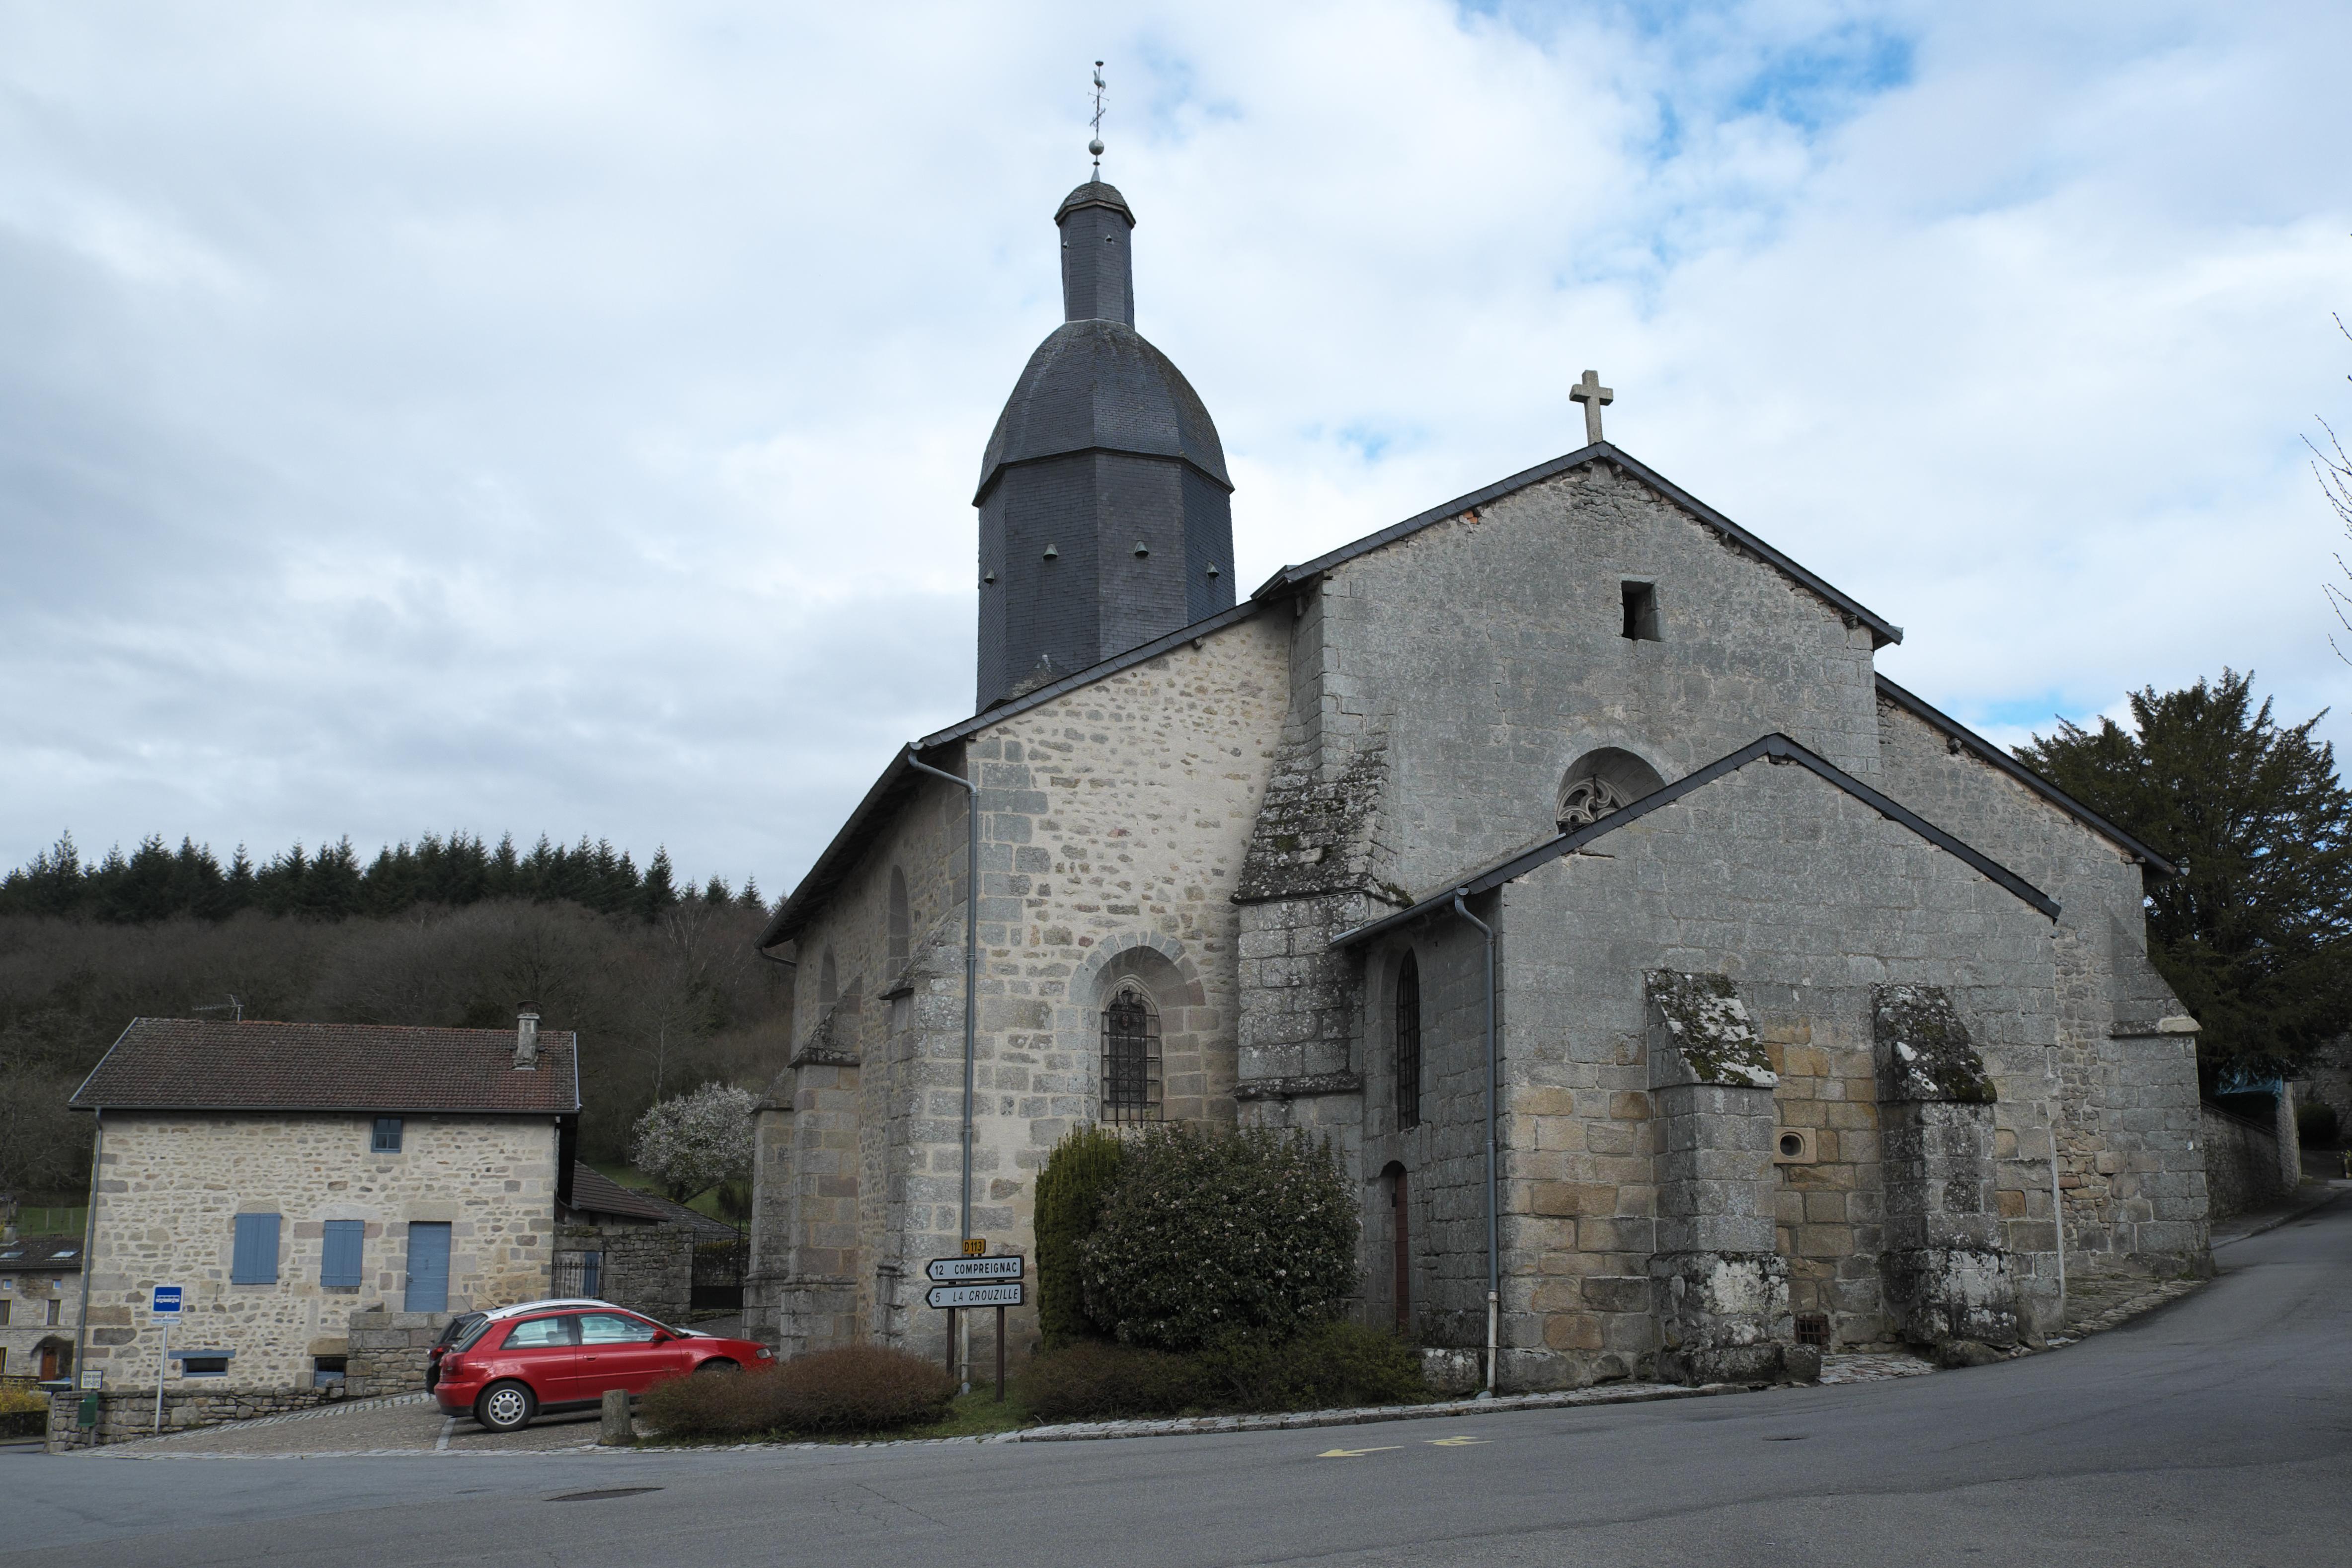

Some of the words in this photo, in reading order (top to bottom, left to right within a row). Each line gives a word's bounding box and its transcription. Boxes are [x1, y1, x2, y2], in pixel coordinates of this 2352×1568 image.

[935, 1265, 943, 1275] 12
[954, 1262, 1017, 1275] COMPREIGNAC
[935, 1292, 941, 1303] 5
[953, 1291, 963, 1302] LA
[969, 1288, 1018, 1301] CROUZILLE
